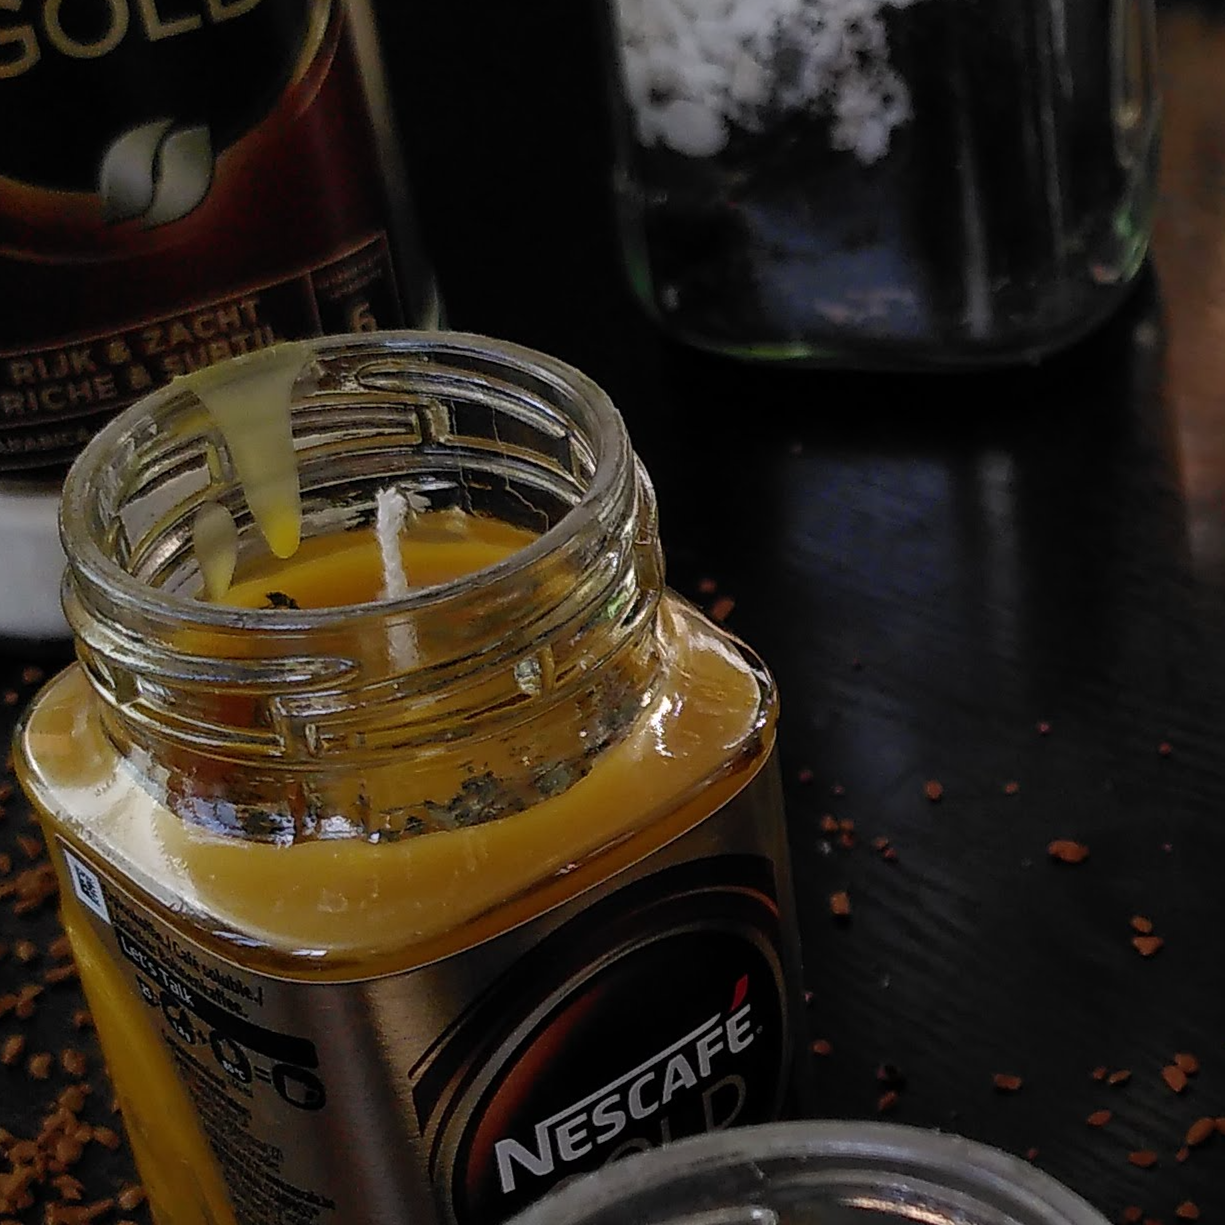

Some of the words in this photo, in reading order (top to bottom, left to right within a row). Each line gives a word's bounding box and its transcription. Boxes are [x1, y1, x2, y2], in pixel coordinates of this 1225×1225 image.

[142, 298, 260, 355] ZACHT
[157, 967, 195, 1007] Talk
[494, 973, 753, 1194] NESCAFÉ
